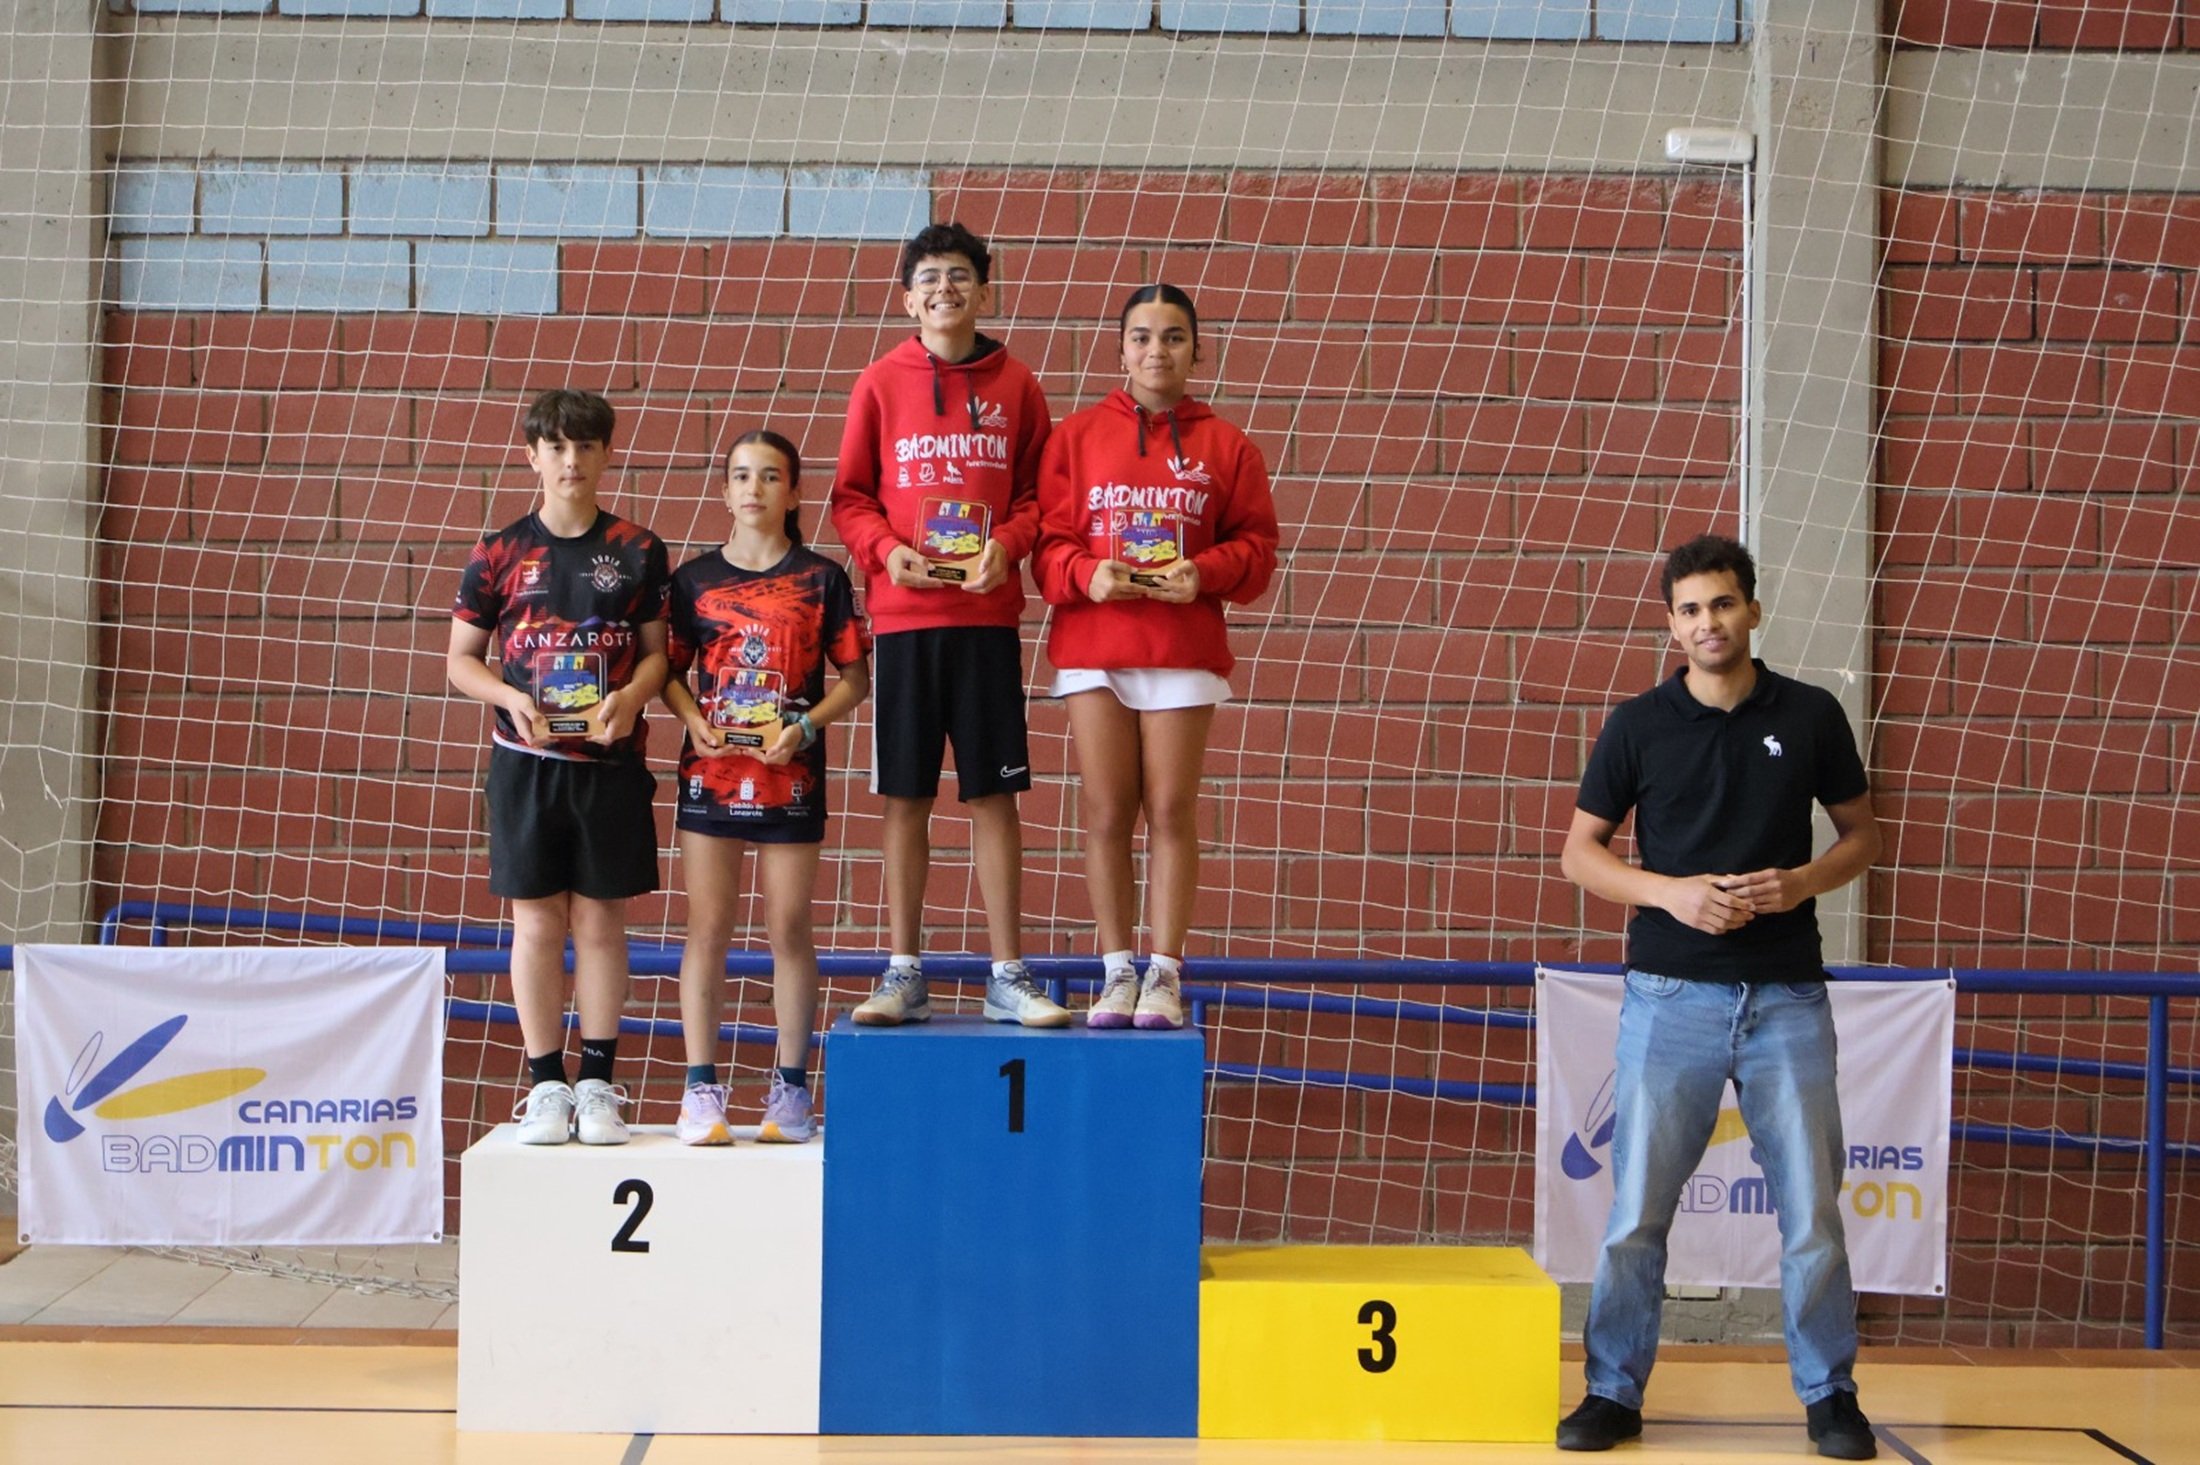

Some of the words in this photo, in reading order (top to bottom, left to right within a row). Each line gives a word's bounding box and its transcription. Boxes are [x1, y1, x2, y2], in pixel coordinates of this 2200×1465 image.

[239, 1096, 417, 1123] CANARIAS
[1000, 1059, 1025, 1132] 1
[102, 1132, 416, 1173] BADMINTON
[611, 1179, 653, 1253] 2
[1358, 1300, 1397, 1373] 3
